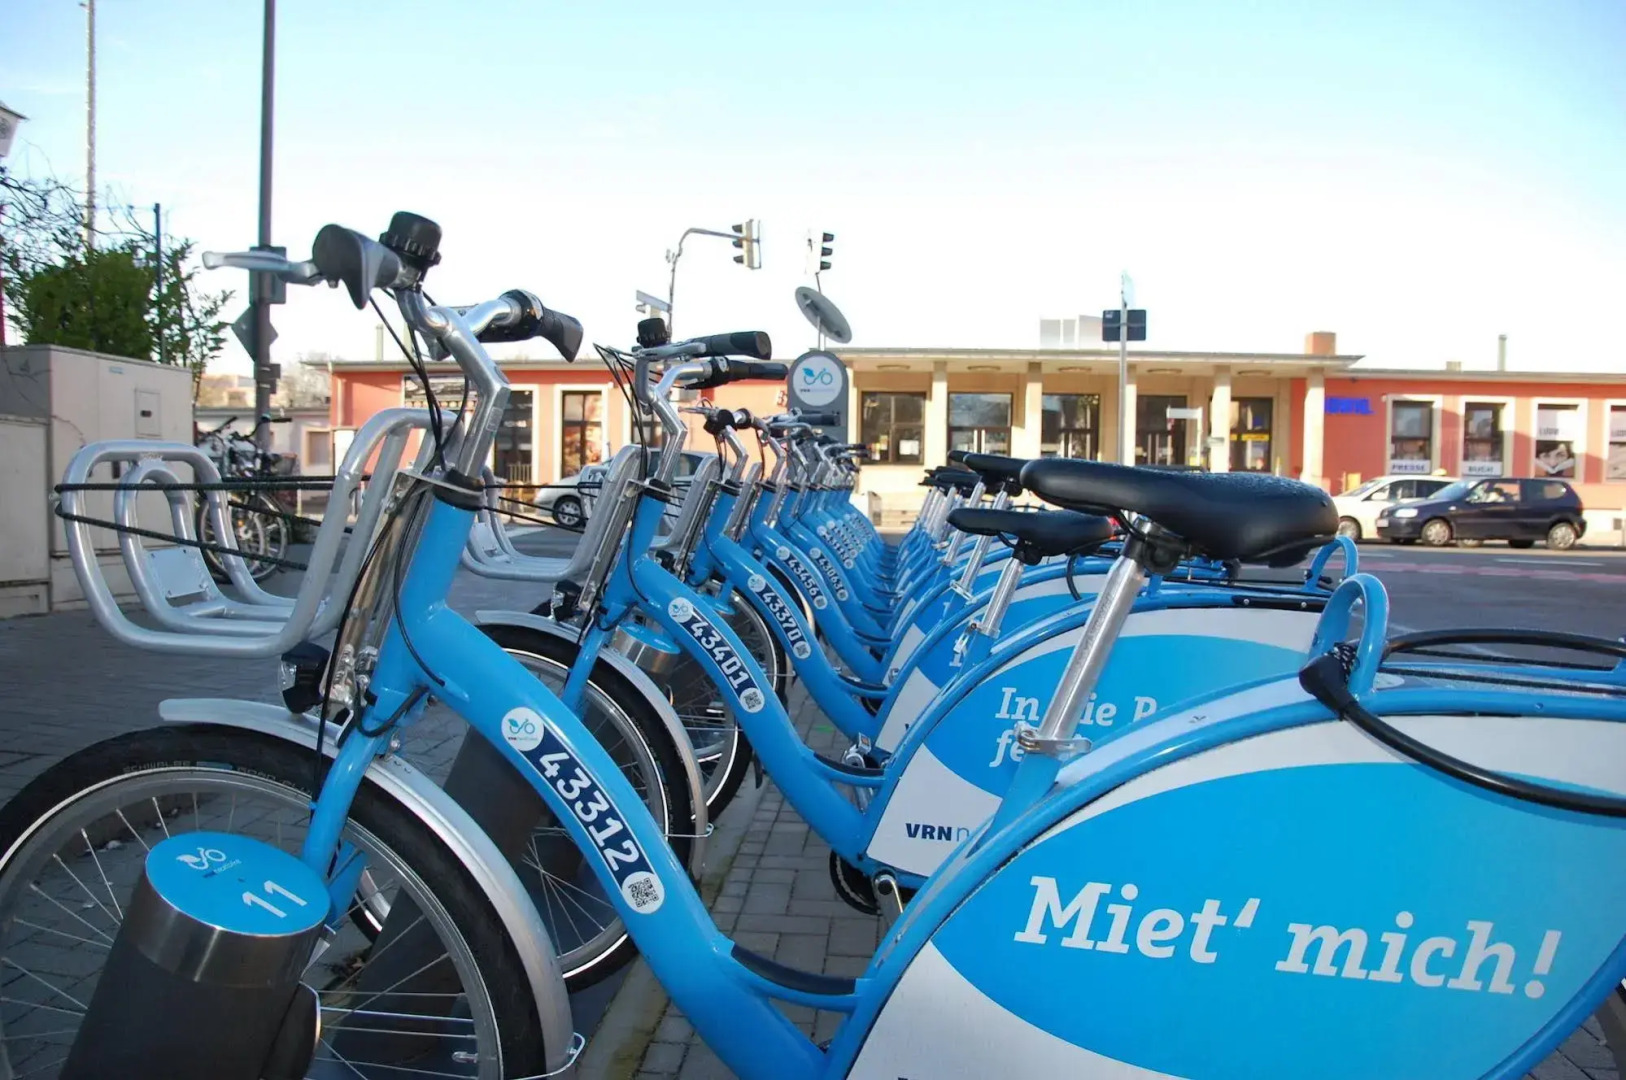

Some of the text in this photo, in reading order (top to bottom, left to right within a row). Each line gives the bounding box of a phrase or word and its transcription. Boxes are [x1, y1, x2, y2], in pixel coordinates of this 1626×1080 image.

[788, 559, 818, 596] 43456
[762, 592, 802, 641] 43370
[690, 621, 749, 689] 43401
[995, 687, 1039, 720] In
[1080, 692, 1117, 726] ie
[539, 752, 640, 871] 43312
[242, 880, 308, 918] 11
[1276, 911, 1561, 998] mich!
